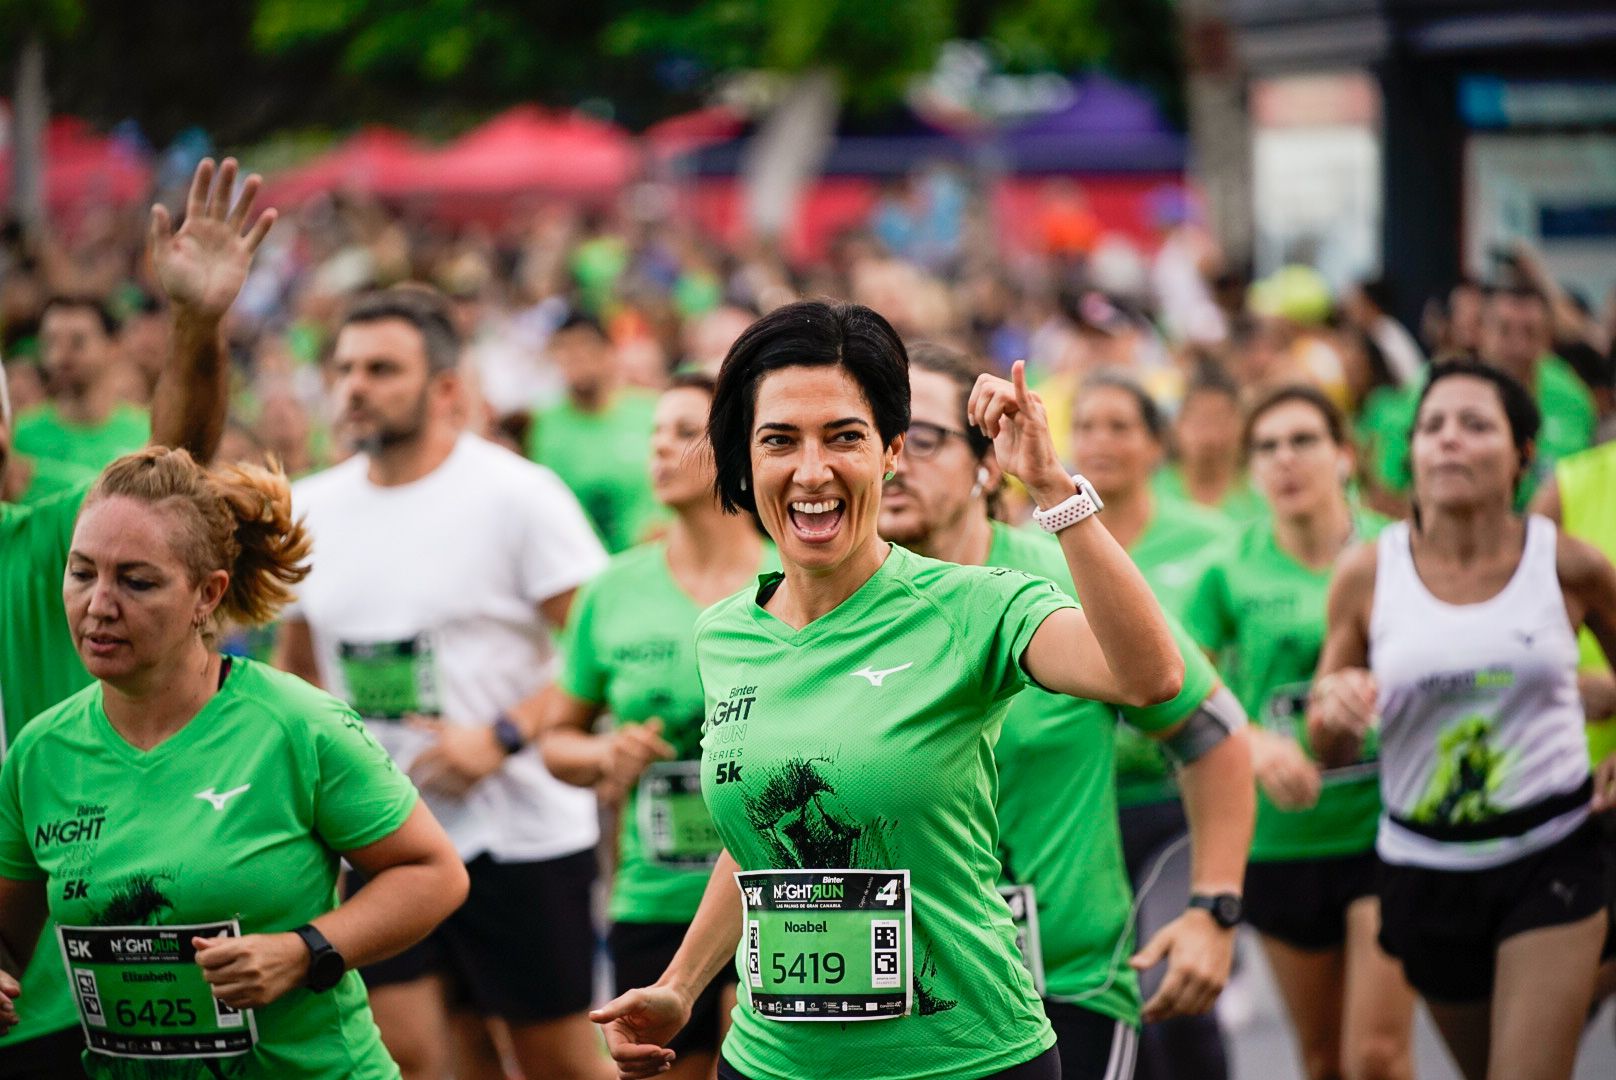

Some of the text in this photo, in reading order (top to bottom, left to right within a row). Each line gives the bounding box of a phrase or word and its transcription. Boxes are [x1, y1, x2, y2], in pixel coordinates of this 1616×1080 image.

[729, 685, 758, 699] Binter
[705, 697, 757, 730] GHT
[708, 748, 744, 761] SERIES
[716, 761, 743, 785] 5k
[35, 817, 106, 849] NIGHT
[822, 876, 844, 884] Binter
[875, 879, 898, 906] 4
[784, 921, 828, 933] Noabel
[68, 939, 93, 959] 5K
[121, 970, 177, 983] Elizabeth
[772, 952, 846, 984] 5419
[115, 999, 197, 1028] 6425
